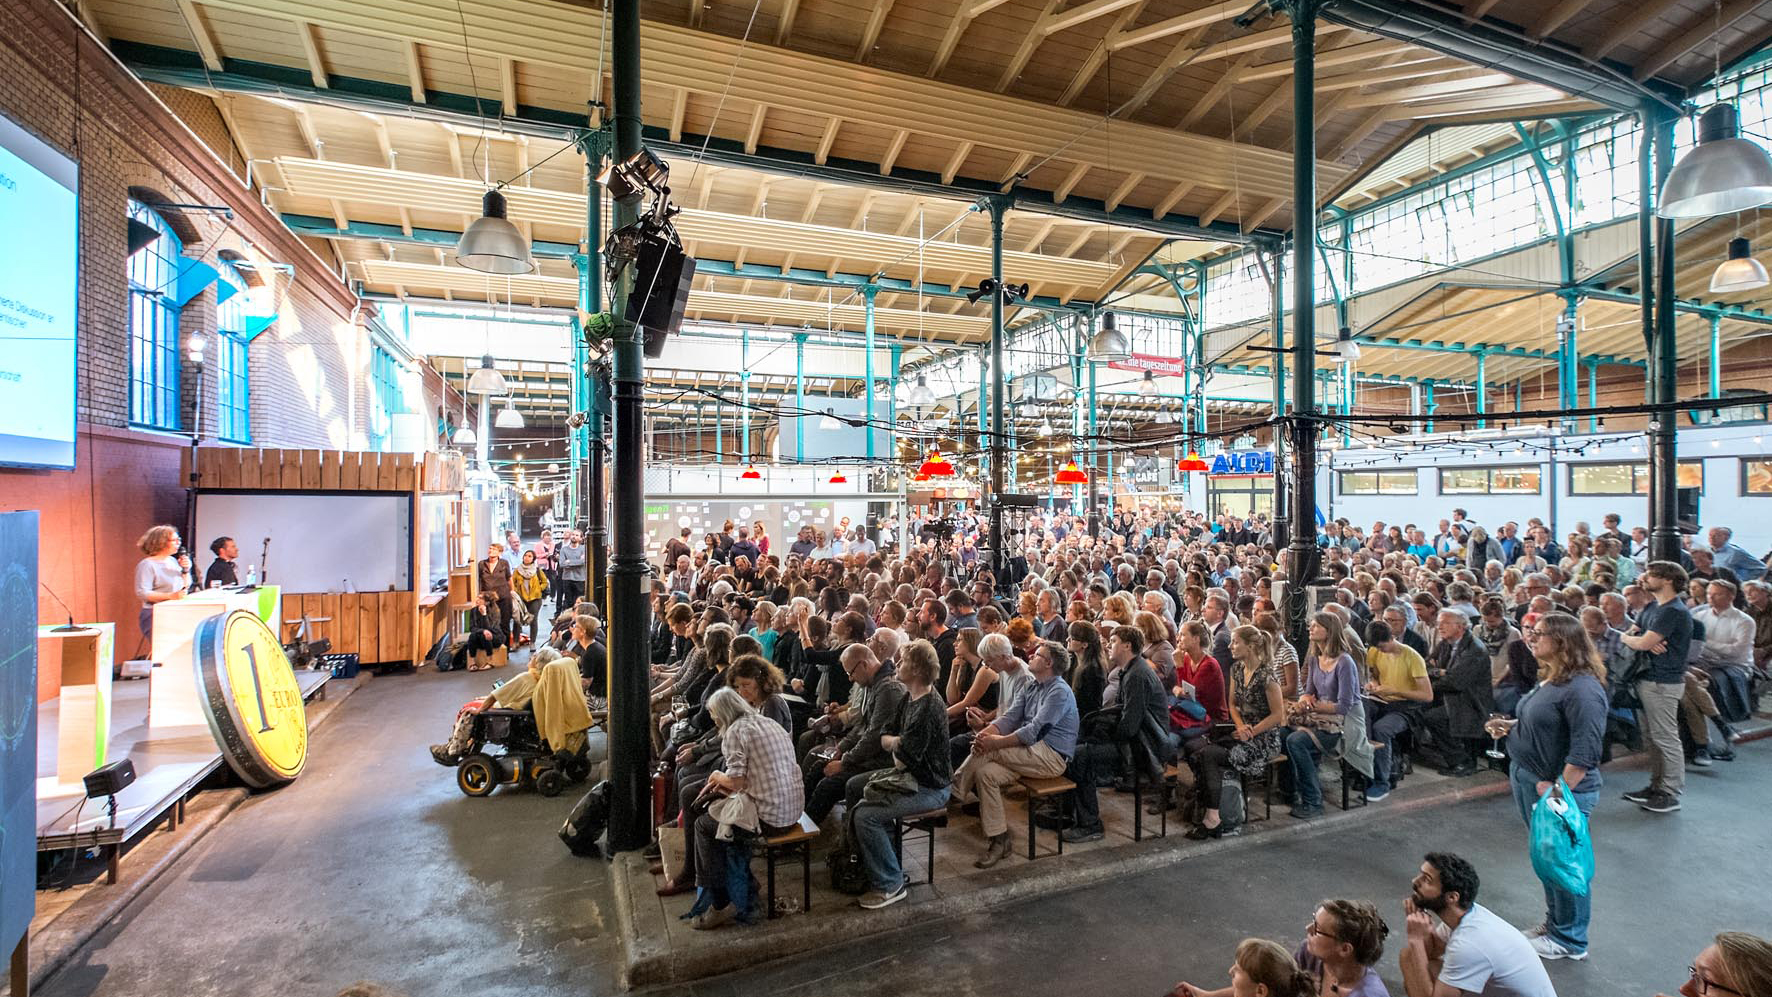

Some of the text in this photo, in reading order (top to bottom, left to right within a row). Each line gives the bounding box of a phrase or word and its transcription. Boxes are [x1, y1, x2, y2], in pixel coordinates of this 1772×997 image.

[1140, 358, 1182, 374] tageszeitung
[1211, 451, 1274, 474] ALDI
[1135, 468, 1158, 483] CAFÉ
[241, 642, 274, 734] 1
